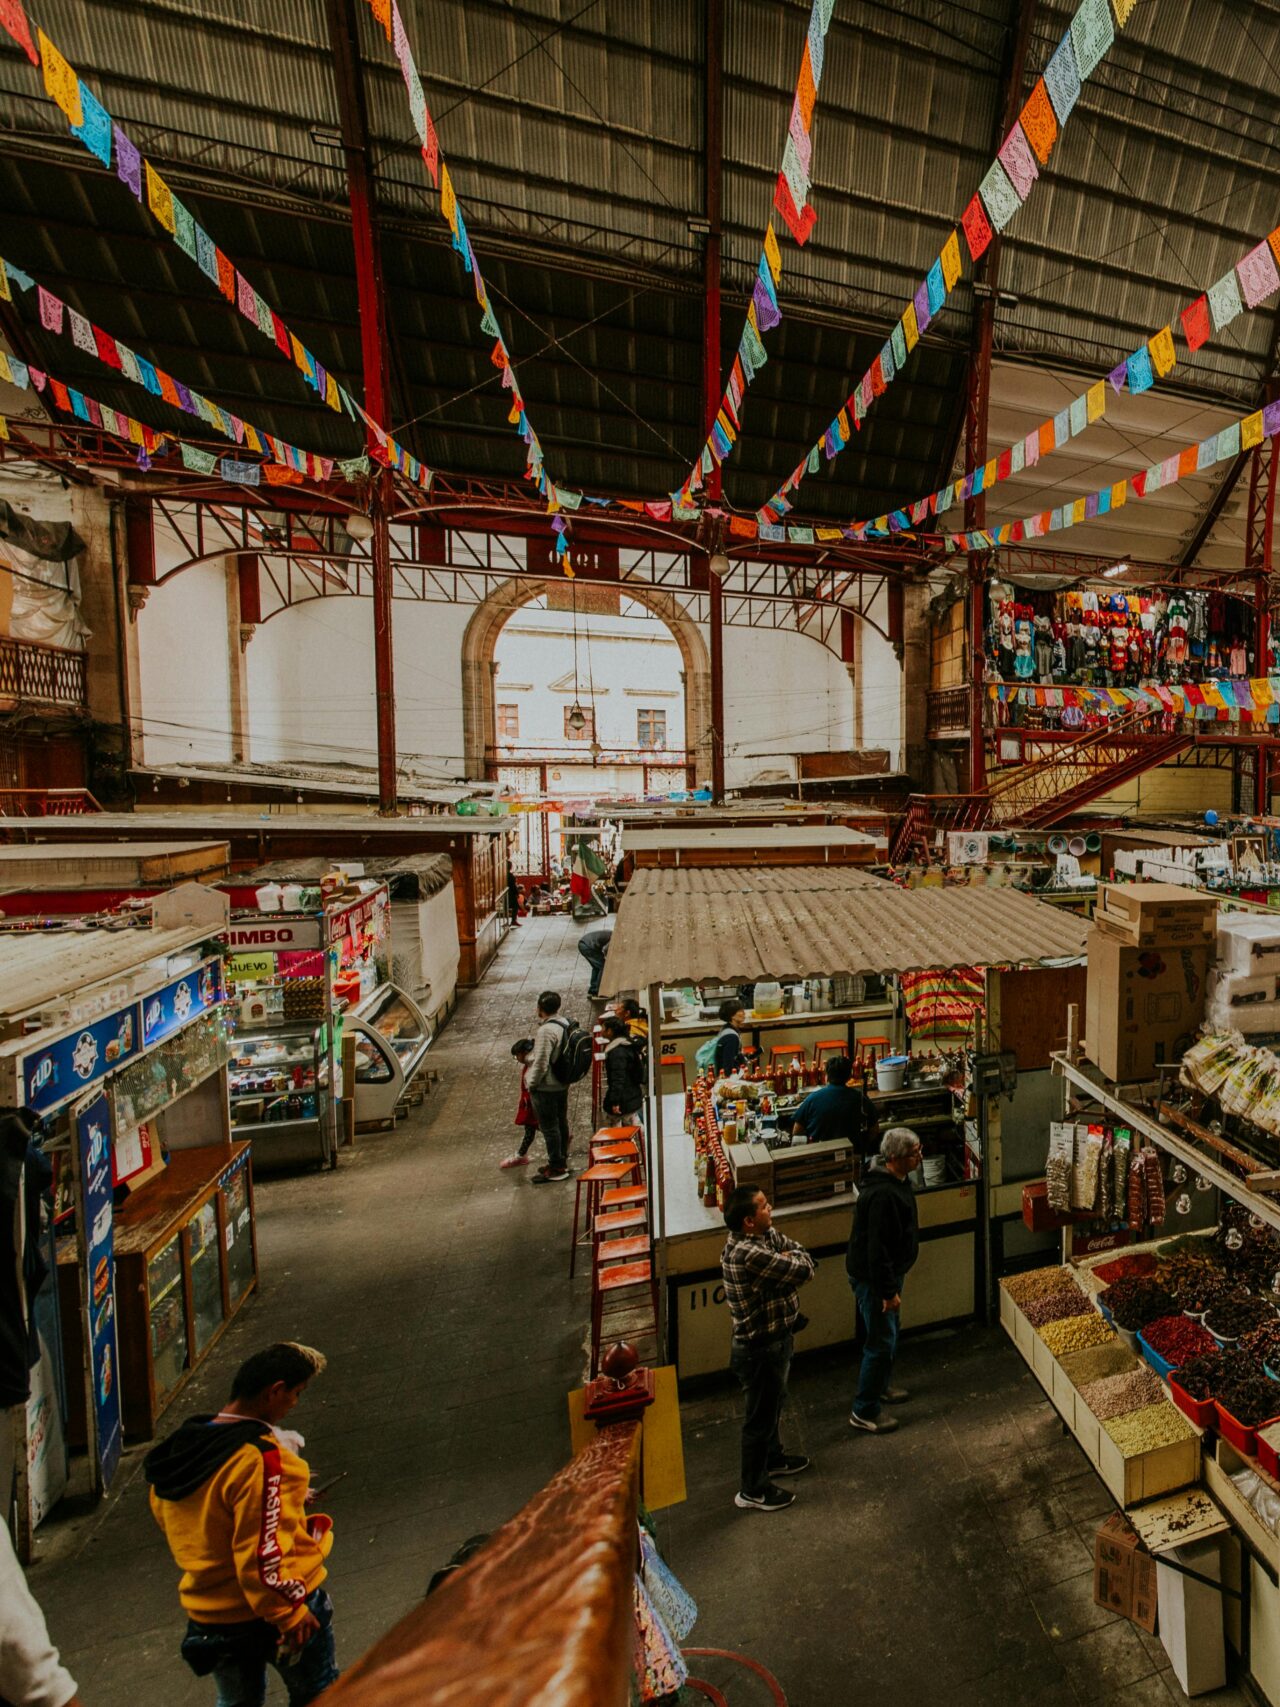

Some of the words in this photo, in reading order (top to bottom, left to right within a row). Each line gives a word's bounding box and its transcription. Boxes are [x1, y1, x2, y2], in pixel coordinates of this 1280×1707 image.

[217, 928, 294, 945] BIMBO
[230, 960, 268, 975] HUEVO
[661, 1043, 677, 1055] 85
[30, 1058, 53, 1098] FUD
[86, 1129, 102, 1179] FUD
[263, 1475, 281, 1556] FASHION
